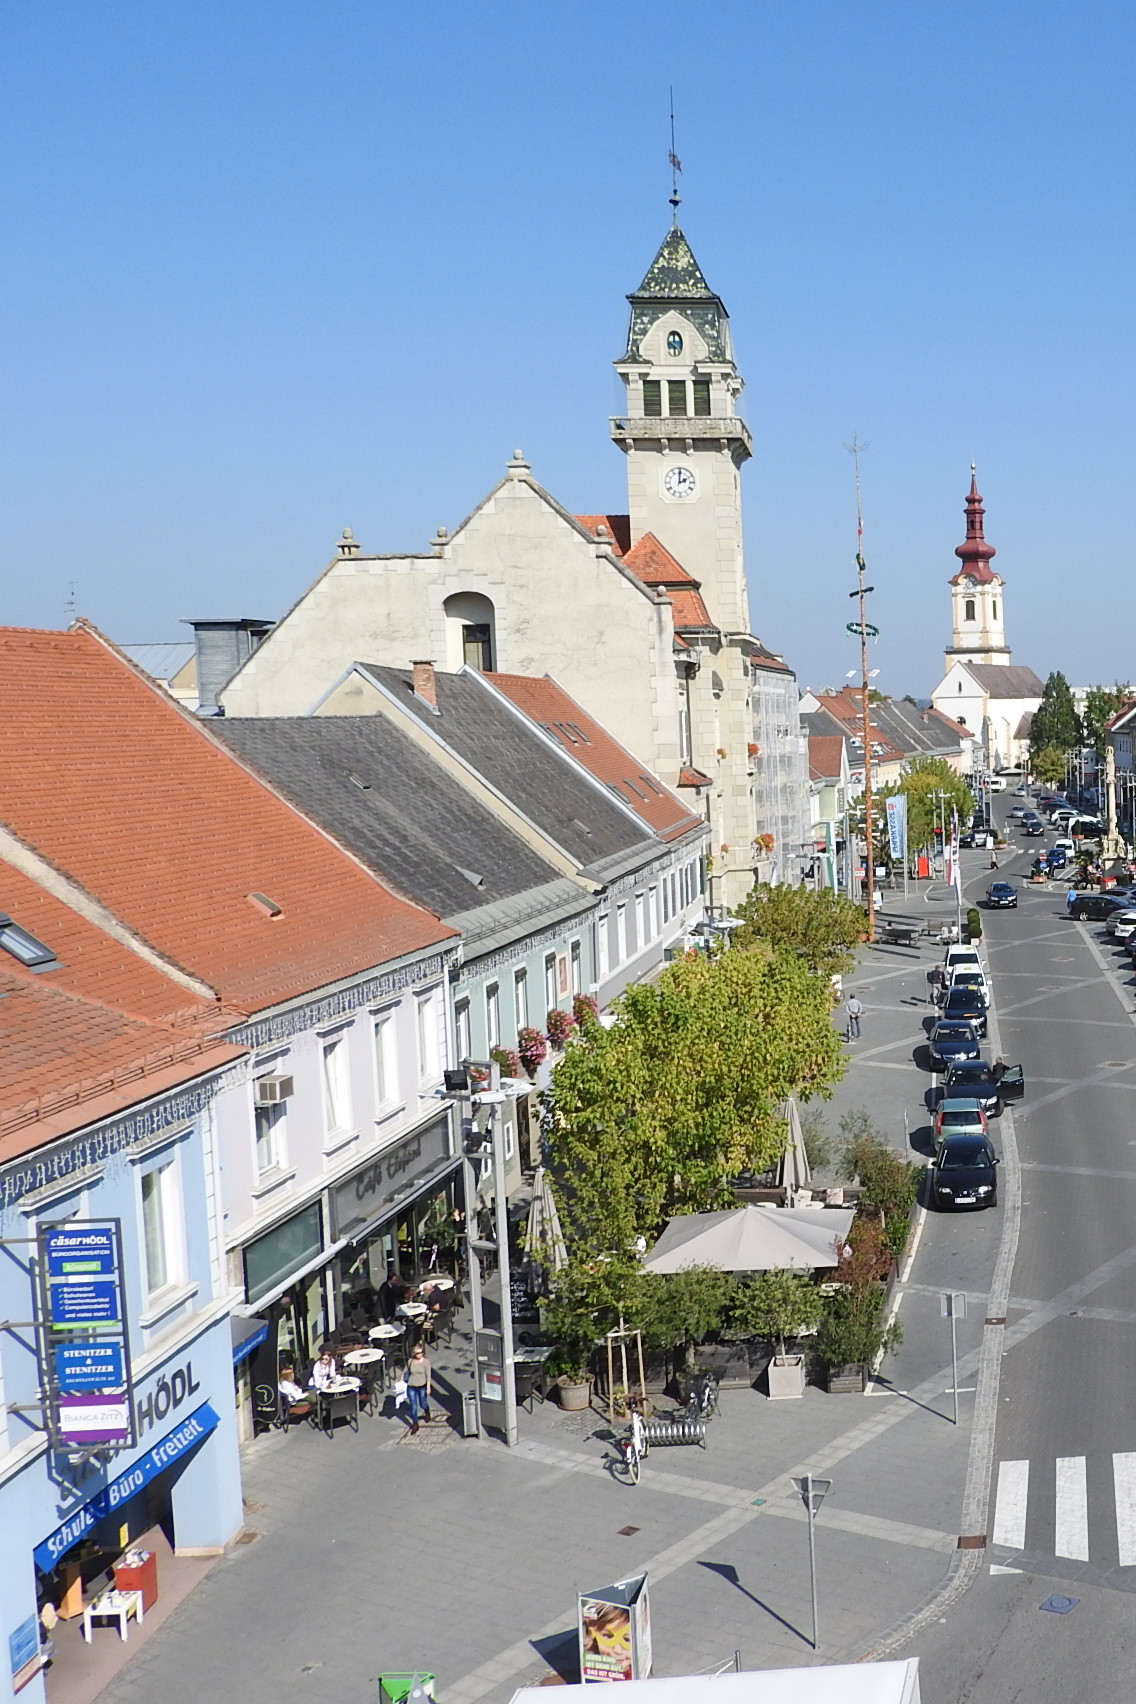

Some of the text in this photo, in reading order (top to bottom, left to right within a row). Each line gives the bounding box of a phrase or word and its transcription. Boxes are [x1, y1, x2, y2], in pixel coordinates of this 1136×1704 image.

[63, 1348, 113, 1358] STENITZER
[65, 1365, 114, 1375] STENITZER
[136, 1360, 201, 1439] HÖDL
[47, 1508, 95, 1560] Schule
[108, 1470, 144, 1506] Büro
[151, 1417, 204, 1468] Freizeit
[586, 1668, 598, 1676] DAS
